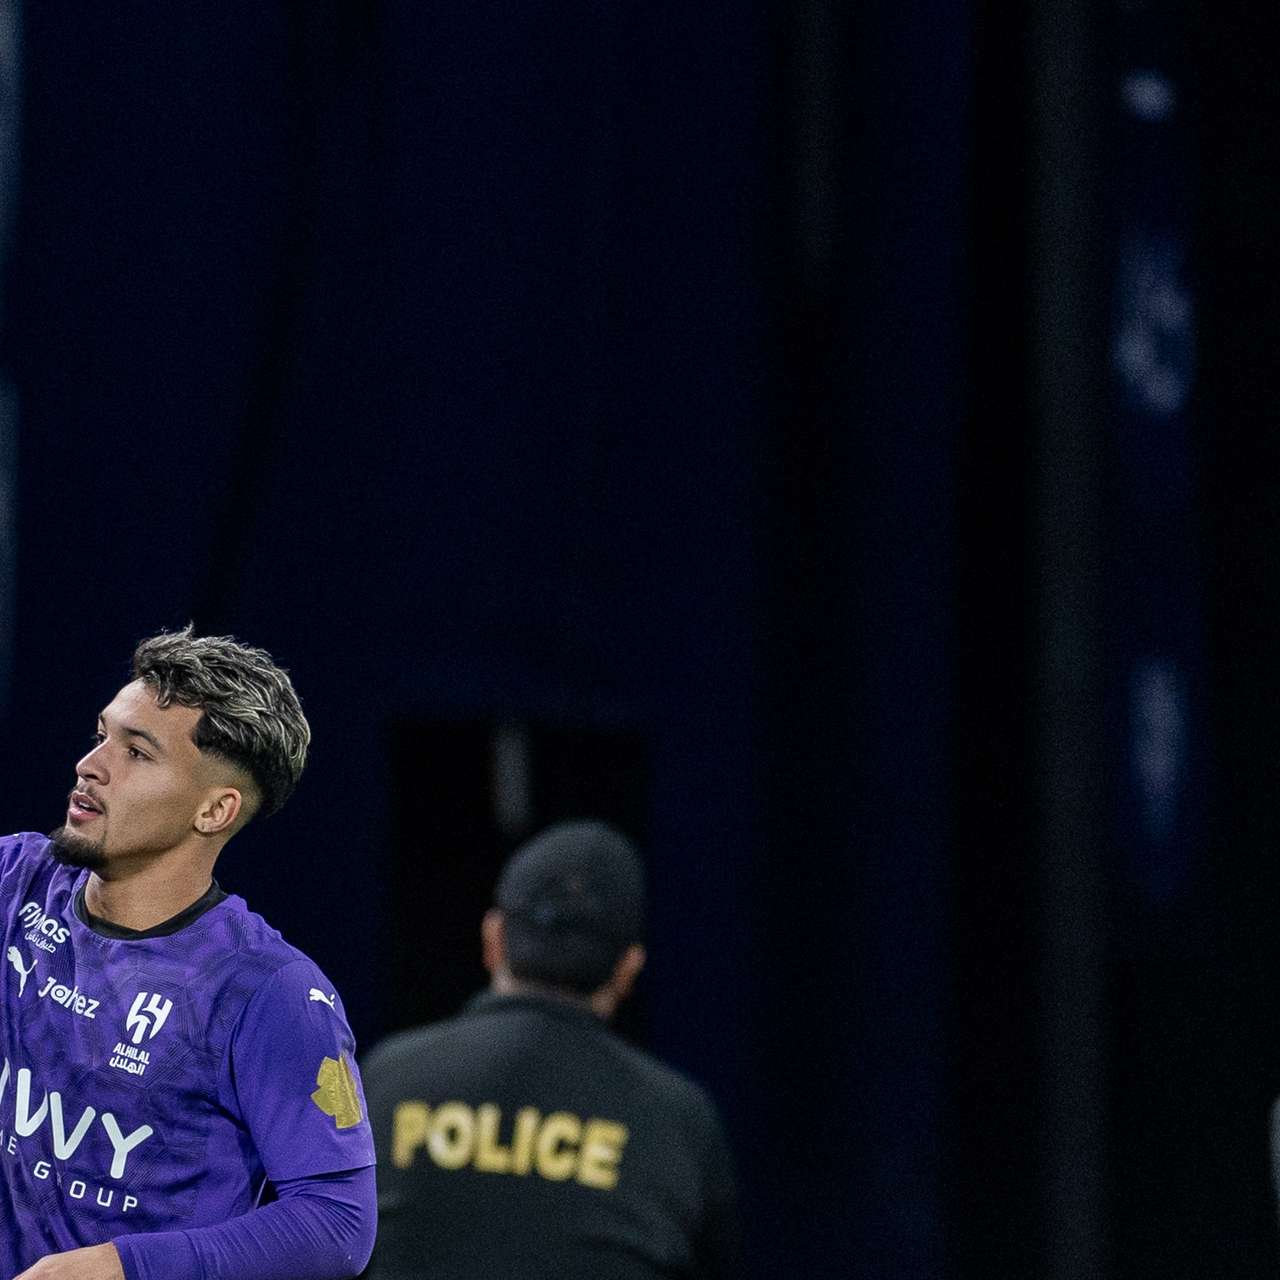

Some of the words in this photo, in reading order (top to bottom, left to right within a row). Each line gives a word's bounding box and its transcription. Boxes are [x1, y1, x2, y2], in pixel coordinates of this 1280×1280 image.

[109, 1057, 146, 1076] الهلال
[392, 1101, 629, 1190] POLICE
[33, 1160, 138, 1212] GOUP
